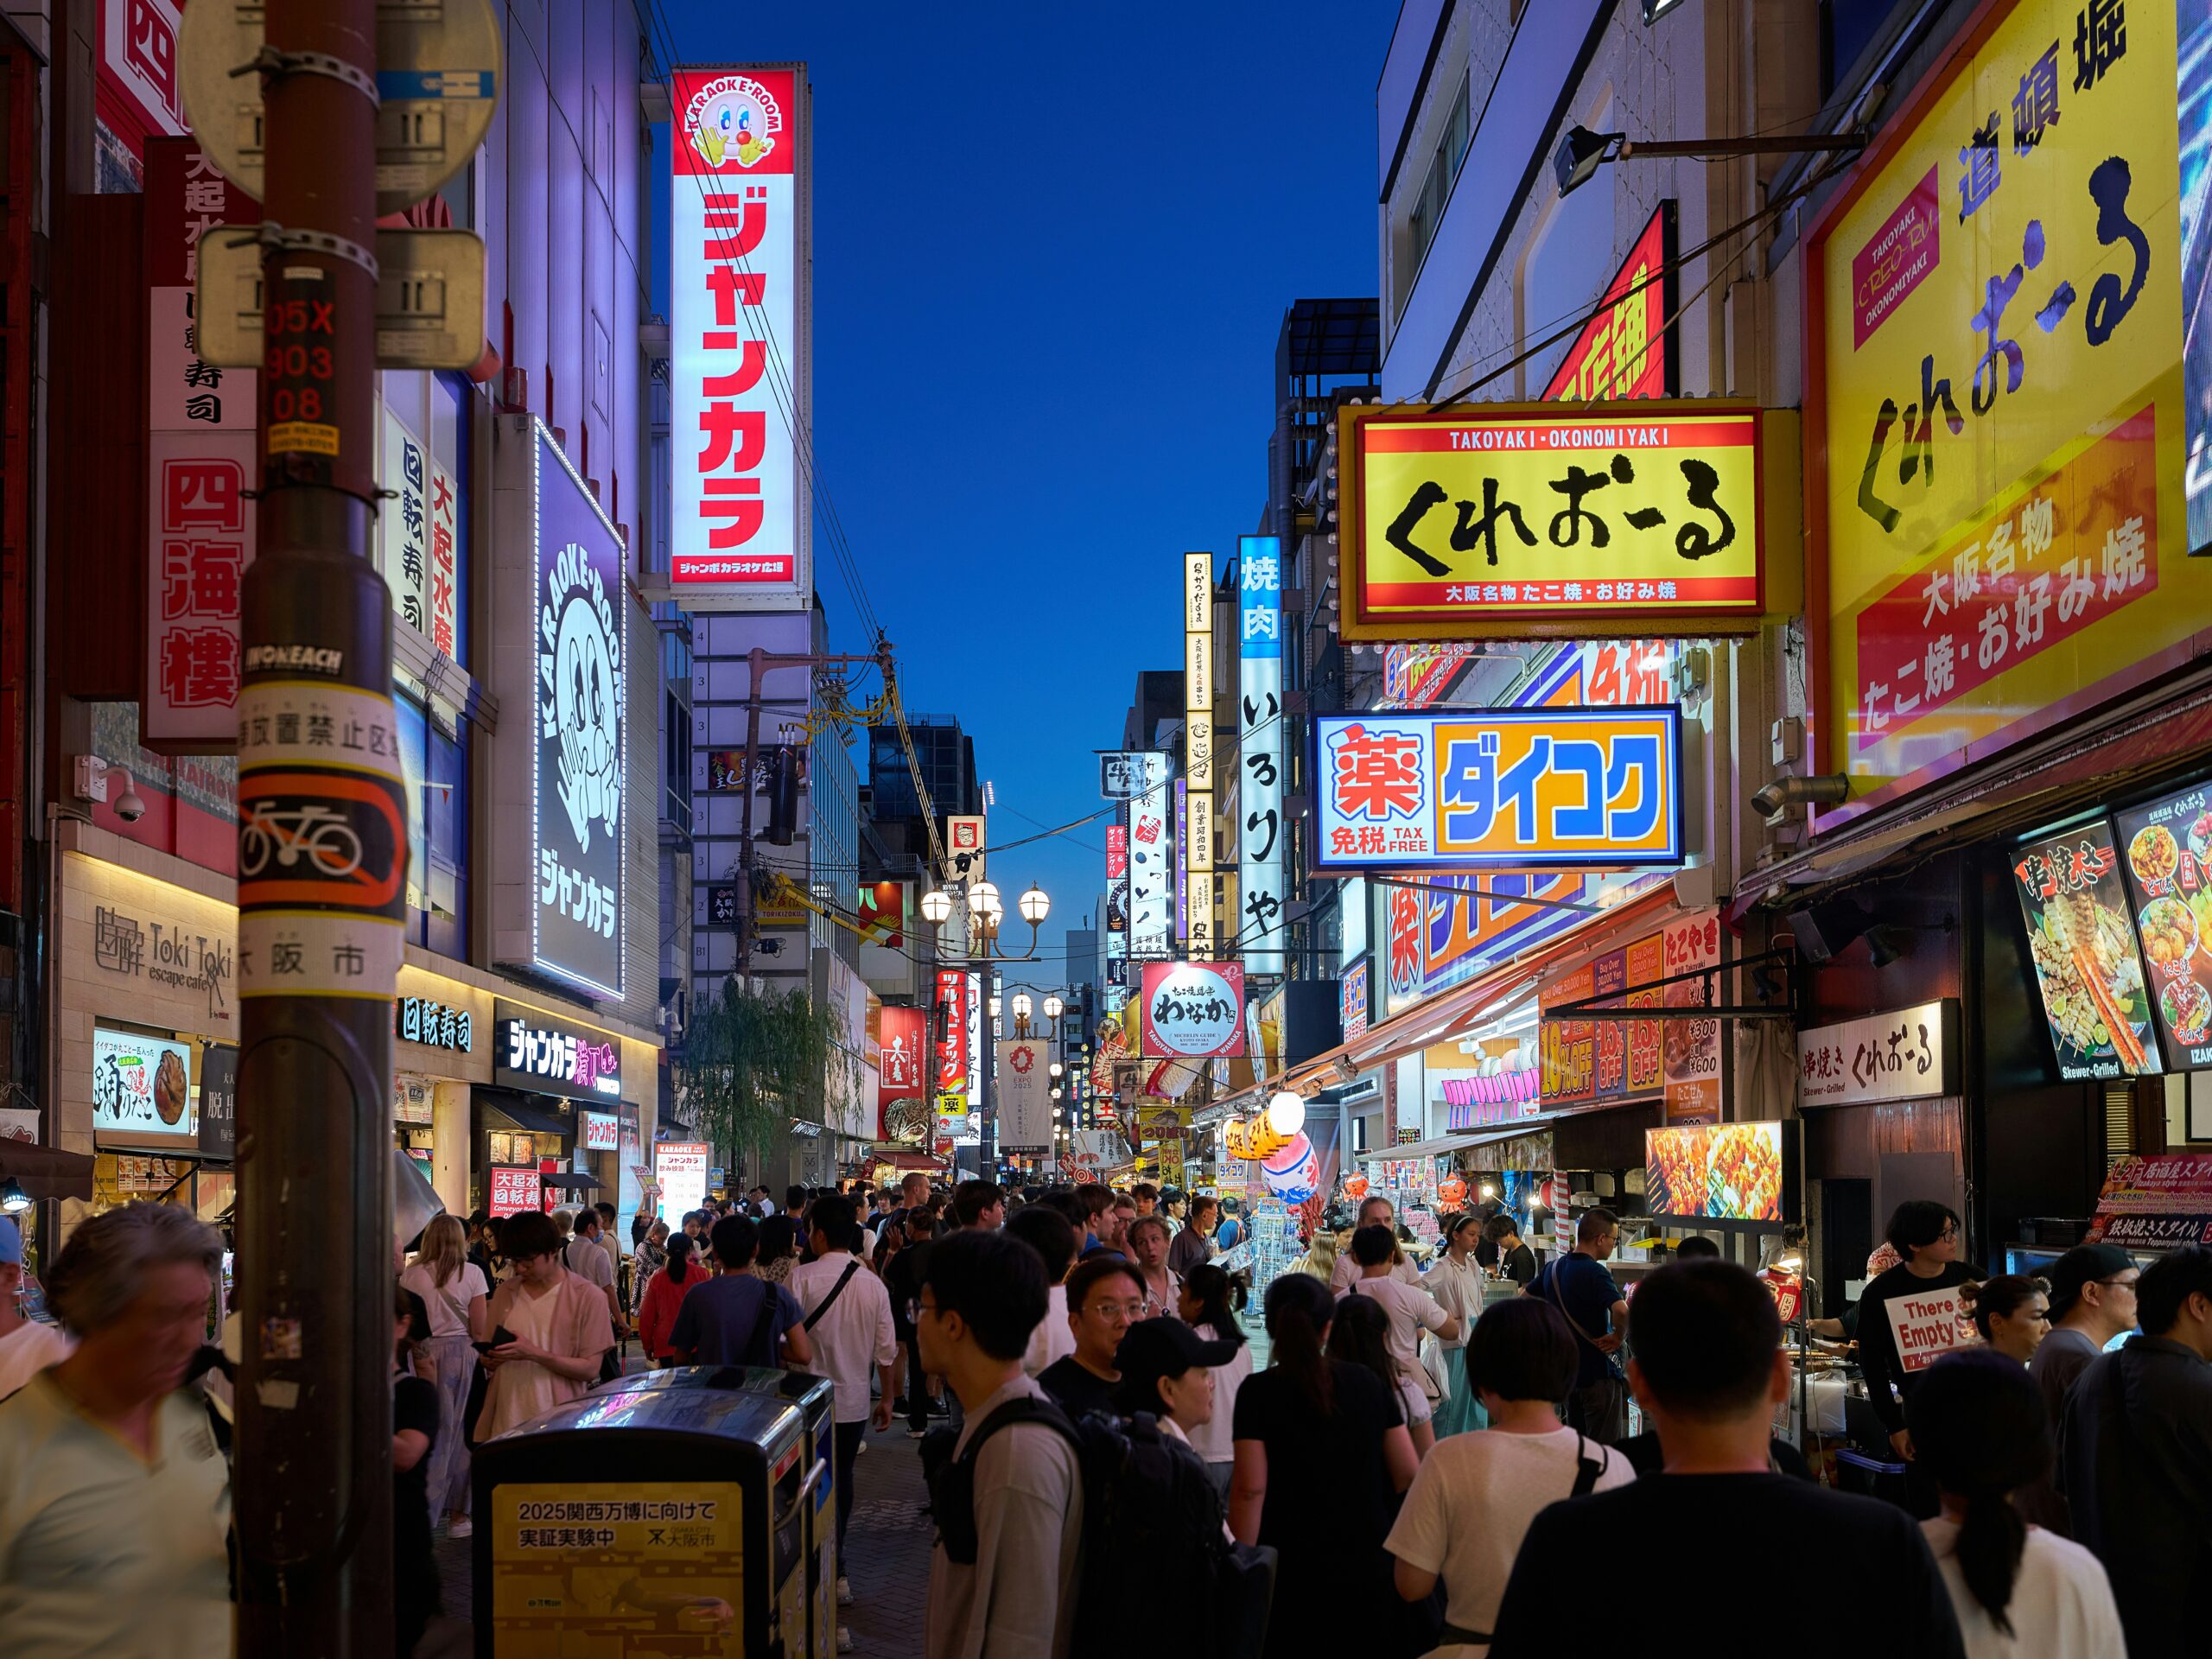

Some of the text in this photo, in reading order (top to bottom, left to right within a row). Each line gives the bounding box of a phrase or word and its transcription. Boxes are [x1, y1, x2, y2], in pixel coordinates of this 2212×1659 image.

[1958, 0, 2127, 227] 道頓堀
[1872, 206, 1916, 265] TAKOYAKI
[1865, 251, 1928, 327] OKONOMIYAKI
[1858, 156, 2151, 533] くれおーる
[698, 186, 767, 549] ジャンカラ
[273, 390, 322, 421] 08
[1385, 454, 1736, 577] くれおーる
[433, 474, 454, 658] 大起水産
[680, 562, 784, 575] ジャンボカラオケ広場
[1922, 497, 2053, 628] 大阪名物
[1241, 556, 1280, 639] 焼肉
[1446, 585, 1516, 602] 大阪名物
[697, 632, 704, 641] 4
[698, 677, 705, 686] 3
[698, 721, 705, 730] 3
[1337, 726, 1421, 817] 薬
[1441, 731, 1661, 844] ダイコク
[1243, 691, 1280, 936] いろりや
[2175, 792, 2205, 817] くれおーる
[1195, 801, 1206, 862] 創業昭和四年
[1331, 826, 1386, 855] 免税
[1393, 828, 1423, 839] TAX
[1389, 841, 1428, 852] FREE
[698, 856, 704, 865] 3
[2024, 841, 2104, 900] 串焼き
[542, 848, 615, 938] ジャンカラ
[2147, 876, 2175, 895] どて煮
[698, 902, 704, 911] 2
[150, 923, 232, 978] Toki Toki
[696, 947, 706, 956] B1
[1633, 945, 1656, 961] Buy Over
[1666, 918, 1717, 966] たこやき
[1609, 959, 1620, 971] Over
[1647, 957, 1658, 968] Yen
[1686, 962, 1705, 973] Takoyaki
[2164, 958, 2191, 976] たこ焼
[149, 966, 207, 991] escape cafe
[1553, 984, 1563, 995] Over
[1581, 974, 1590, 985] Yen
[1613, 971, 1623, 982] Yen
[1154, 995, 1230, 1025] わなか
[403, 996, 472, 1052] 回転寿司
[1573, 1023, 1583, 1033] FREE
[1689, 1020, 1717, 1039] ¥300
[511, 1019, 601, 1088] ジャンカラ横丁
[1148, 1030, 1173, 1055] TAKOYAKI
[1219, 1030, 1242, 1054] WANAKA
[1632, 1049, 1658, 1084] OFF
[1689, 1057, 1717, 1077] ¥600
[1804, 1046, 1843, 1081] 串焼き
[1853, 1024, 1932, 1088] くれおーる
[1599, 1056, 1623, 1089] OFF
[2063, 1059, 2120, 1079] Skewer-Grilled
[944, 1098, 958, 1112] 薬
[1677, 1085, 1704, 1101] たこせん
[589, 1118, 616, 1143] ジャンカラ
[1220, 1165, 1243, 1177] ダイコク
[2109, 1218, 2200, 1237] 鉄板焼きスタイル
[2147, 1238, 2181, 1247] Teppanyaki
[1904, 1300, 1954, 1319] There
[1898, 1320, 1954, 1348] Empty
[519, 1503, 715, 1521] 2025関西万博に向けて
[519, 1529, 614, 1547] 実証実験中
[667, 1534, 715, 1548] 大阪市
